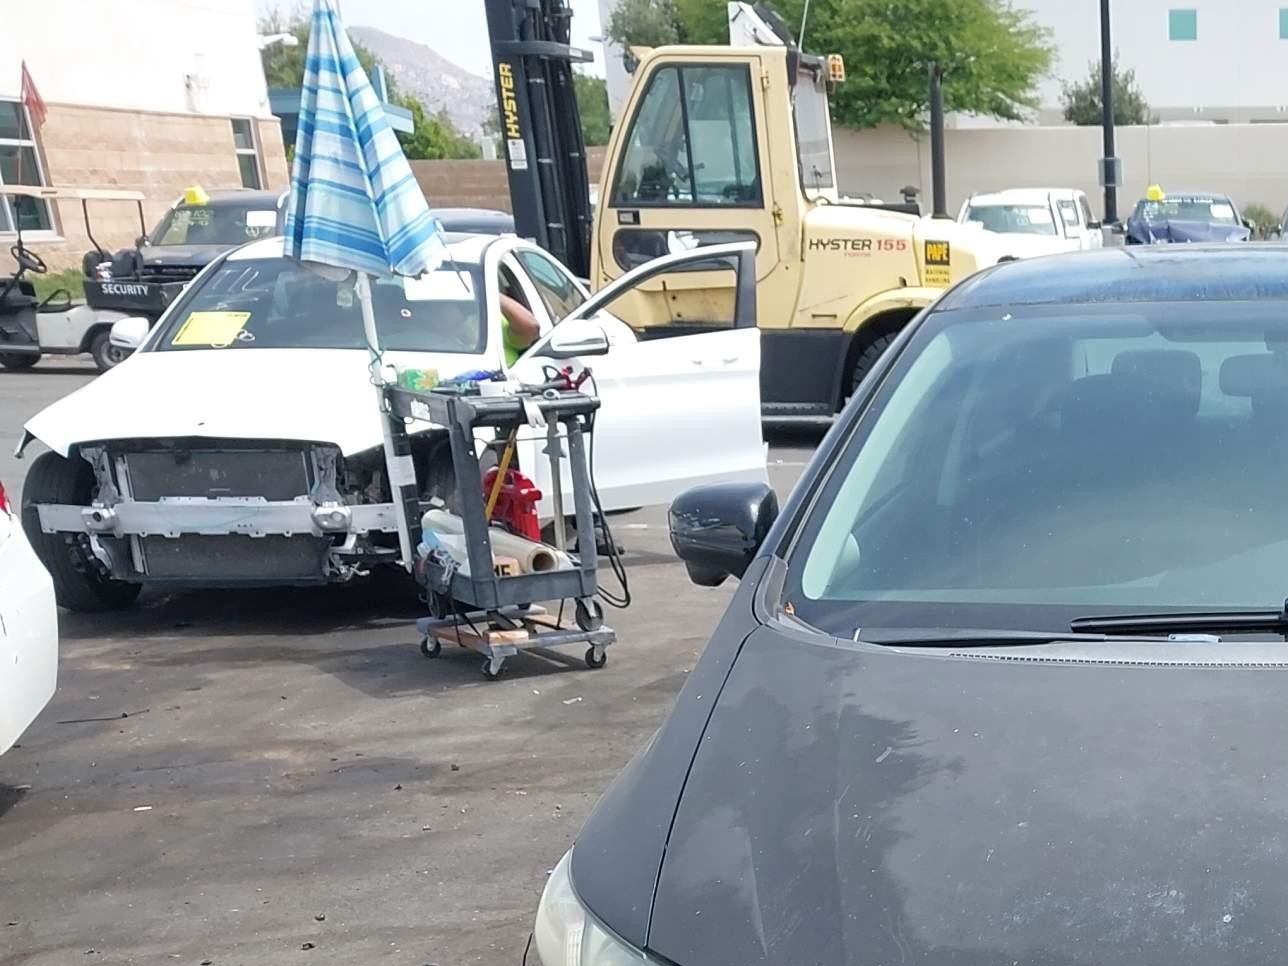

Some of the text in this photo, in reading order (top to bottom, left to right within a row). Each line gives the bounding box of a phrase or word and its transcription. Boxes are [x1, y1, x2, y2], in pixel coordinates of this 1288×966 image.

[499, 63, 520, 138] HYSTER
[809, 239, 907, 251] HYSTER 155
[101, 283, 149, 296] SECURITY
